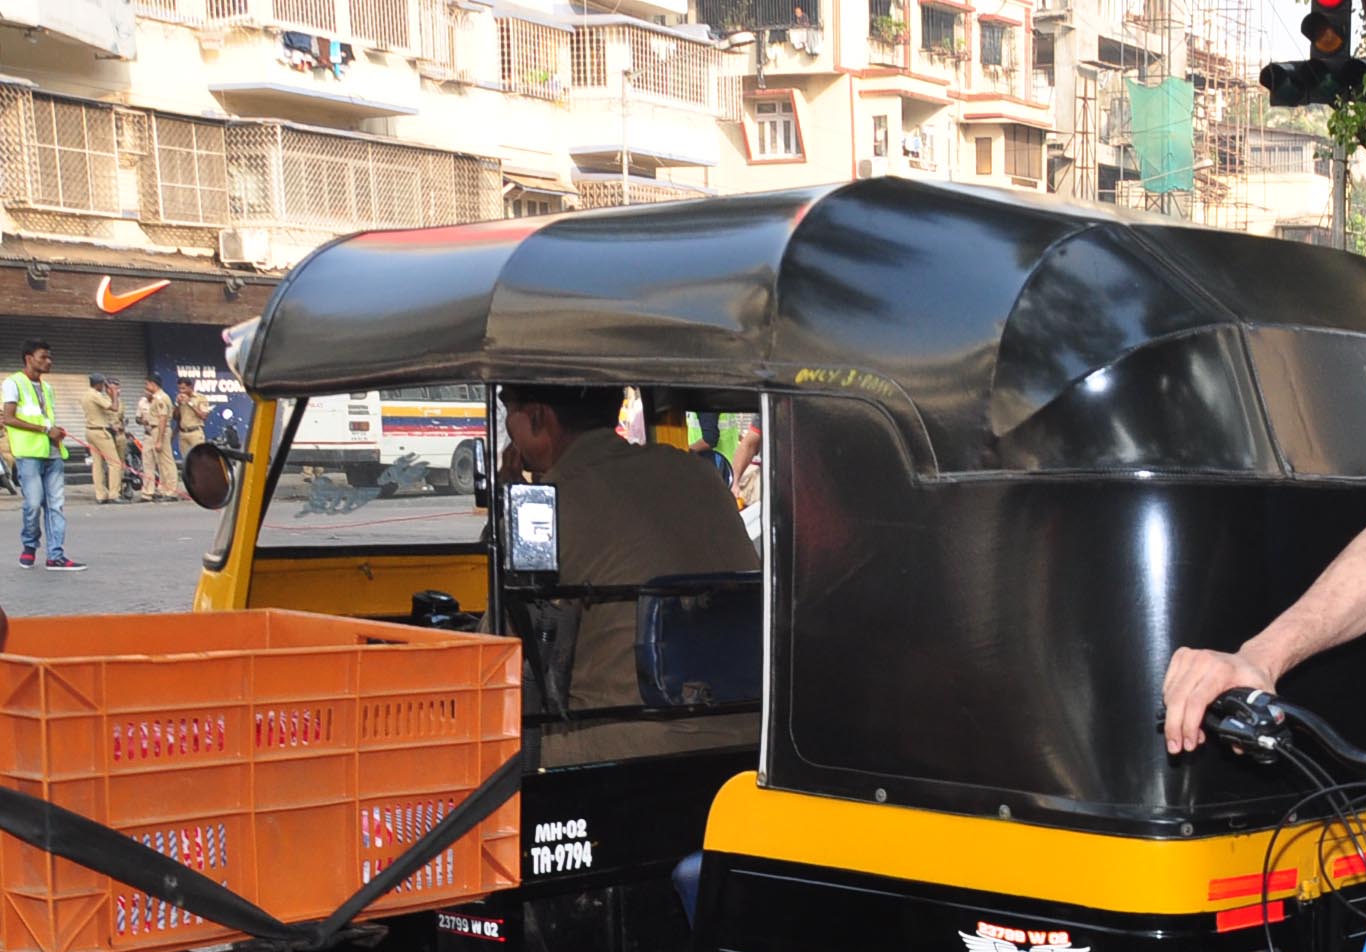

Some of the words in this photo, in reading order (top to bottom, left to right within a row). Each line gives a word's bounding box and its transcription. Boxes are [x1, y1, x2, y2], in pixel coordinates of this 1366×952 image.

[176, 365, 201, 378] WIN
[202, 366, 216, 378] IN
[193, 379, 218, 393] ANY
[438, 913, 470, 933] 23799
[471, 919, 483, 936] W
[483, 921, 500, 938] 02
[1027, 930, 1047, 945] W
